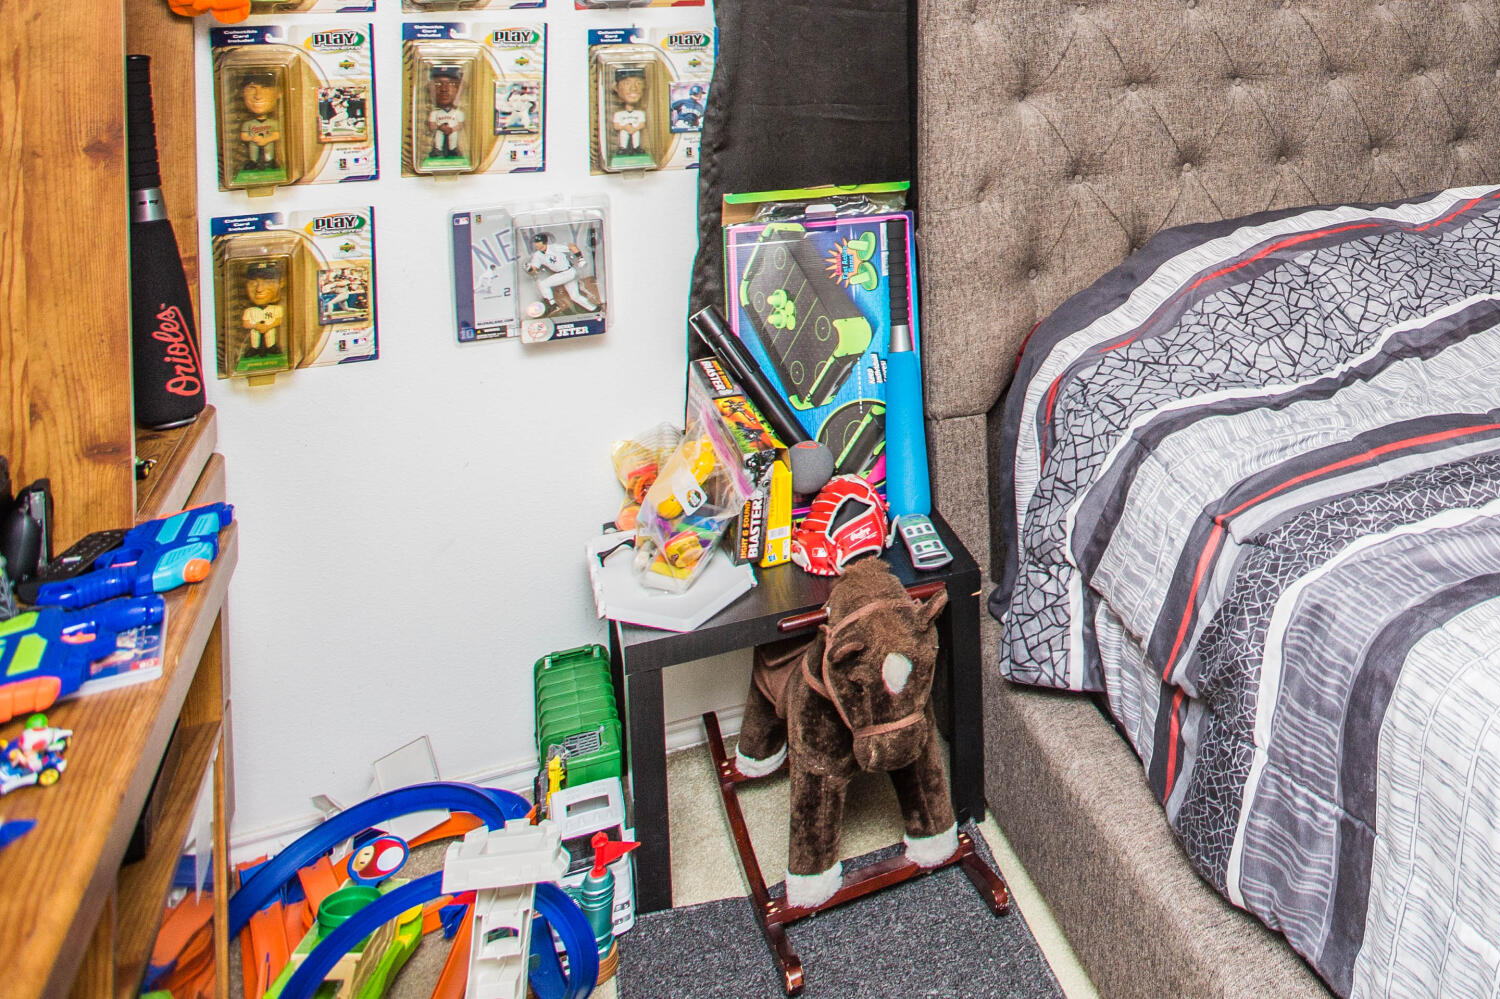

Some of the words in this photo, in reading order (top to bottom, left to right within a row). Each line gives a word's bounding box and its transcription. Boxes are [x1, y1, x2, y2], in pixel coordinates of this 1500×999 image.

[151, 305, 201, 396] Orioles
[556, 326, 589, 337] JETER
[740, 539, 748, 559] LIGHT
[747, 500, 763, 559] BLASTER
